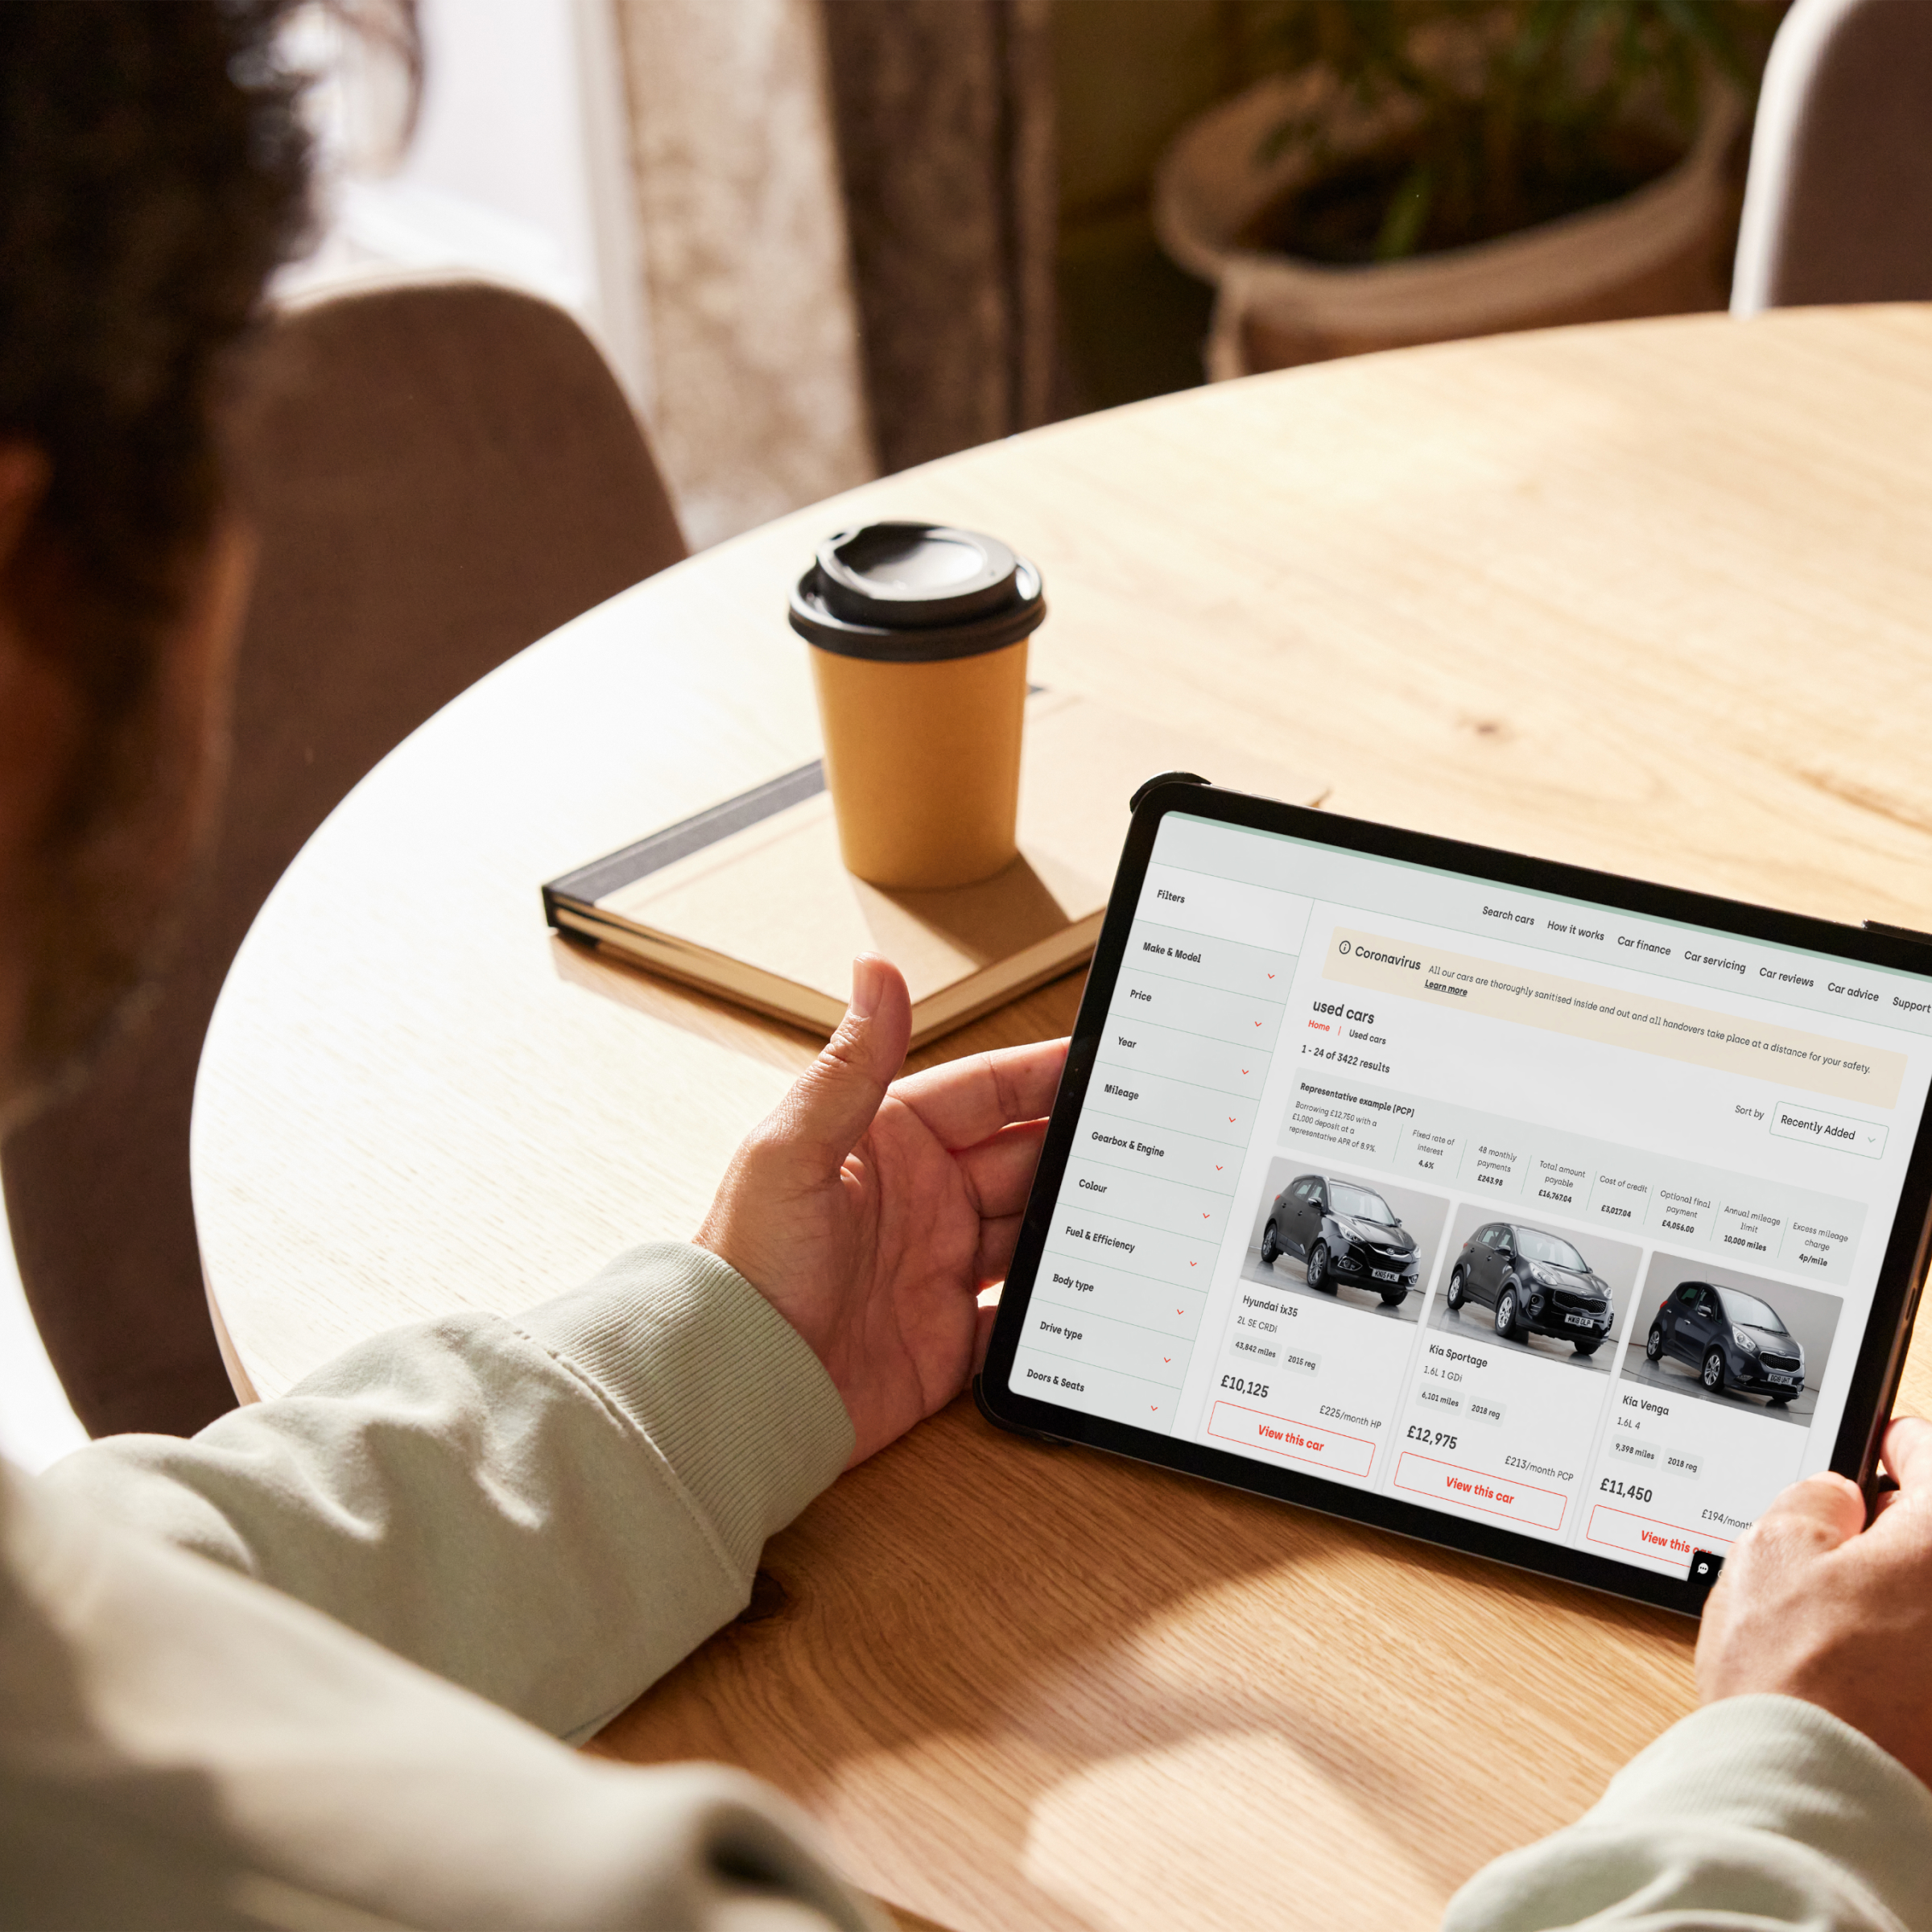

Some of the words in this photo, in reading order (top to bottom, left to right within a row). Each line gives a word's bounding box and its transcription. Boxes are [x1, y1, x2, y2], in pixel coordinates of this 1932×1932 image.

[1156, 889, 1186, 904] Filters
[1482, 906, 1513, 921] Search
[1514, 914, 1535, 926] cars
[1546, 920, 1568, 933] How
[1569, 924, 1577, 935] it
[1578, 928, 1605, 941] works
[1142, 941, 1166, 955] Make
[1166, 947, 1174, 957] &
[1174, 949, 1202, 964] Model
[1617, 935, 1636, 947] Car
[1636, 939, 1671, 956] finance
[1355, 946, 1422, 971] Coronavirus
[1684, 950, 1703, 962] Car
[1703, 956, 1747, 975] servicing
[1759, 967, 1777, 979] Car
[1778, 972, 1814, 988] reviews
[1129, 989, 1152, 1002] Price
[1424, 979, 1447, 993] Learn
[1447, 985, 1468, 997] more
[1827, 982, 1846, 994] Car
[1847, 988, 1880, 1002] advice
[1312, 1001, 1345, 1018] used
[1345, 1009, 1375, 1025] cars
[1892, 996, 1931, 1013] Support
[1307, 1019, 1331, 1032] Home
[1428, 965, 1441, 976] All
[1441, 970, 1455, 978] our
[1456, 973, 1474, 983] cars
[1475, 977, 1489, 986] are
[1490, 979, 1534, 997] thoroughly
[1534, 991, 1573, 1005] sanitised
[1573, 997, 1598, 1011] inside
[1599, 1005, 1616, 1015] and
[1616, 1009, 1631, 1018] out
[1631, 1013, 1649, 1022] and
[1649, 1016, 1662, 1026] all
[1662, 1018, 1705, 1035] handovers
[1707, 1029, 1725, 1040] take
[1725, 1034, 1751, 1046] place
[1752, 1040, 1762, 1049] at
[1770, 1043, 1807, 1059] distance
[1809, 1051, 1822, 1062] for
[1822, 1056, 1842, 1066] your
[1843, 1061, 1870, 1075] safety.
[1118, 1036, 1137, 1049] Year
[1348, 1029, 1369, 1041] Used
[1368, 1035, 1387, 1045] cars
[1301, 1044, 1307, 1054] 1
[1313, 1046, 1325, 1058] 24
[1325, 1051, 1337, 1060] of
[1336, 1052, 1359, 1066] 3422
[1359, 1060, 1390, 1074] results
[1104, 1084, 1139, 1101] Mileage
[1299, 1082, 1358, 1103] Representative
[1359, 1097, 1392, 1112] example
[1295, 1100, 1330, 1117] Borrowing
[1330, 1109, 1356, 1121] £12,750
[1356, 1117, 1371, 1125] with
[1735, 1104, 1752, 1117] Sort
[1753, 1108, 1765, 1121] by
[1292, 1113, 1314, 1125] £1,000
[1315, 1119, 1340, 1131] deposit
[1781, 1114, 1823, 1135] Recently
[1823, 1125, 1856, 1141] Added
[1091, 1131, 1129, 1148] Gearbox
[1128, 1140, 1135, 1150] &
[1136, 1141, 1165, 1158] Engine
[1289, 1126, 1337, 1143] representative
[1337, 1137, 1352, 1146] APR
[1360, 1142, 1376, 1152] 8.9%.
[1412, 1129, 1431, 1140] Fixed
[1431, 1135, 1446, 1144] rate
[1417, 1145, 1443, 1156] interest
[1478, 1146, 1488, 1154] 48
[1488, 1150, 1517, 1162] monthly
[1418, 1159, 1435, 1170] 4.6%
[1476, 1159, 1511, 1173] payments
[1540, 1160, 1558, 1171] Total
[1558, 1166, 1586, 1179] amount
[1079, 1179, 1108, 1194] Colour
[1477, 1174, 1504, 1187] £243.98
[1544, 1176, 1574, 1188] payable
[1600, 1175, 1616, 1186] Cost
[1626, 1183, 1648, 1193] credit
[1538, 1189, 1572, 1203] £16,767.04
[1660, 1190, 1693, 1204] Optional
[1693, 1197, 1711, 1209] final
[1600, 1204, 1632, 1218] £3,017.04
[1666, 1206, 1698, 1219] payment
[1724, 1206, 1750, 1218] Annual
[1750, 1213, 1781, 1227] mileage
[1662, 1220, 1695, 1234] £4,056.00
[1740, 1222, 1758, 1233] limit
[1793, 1222, 1817, 1235] Excess
[1818, 1229, 1848, 1243] mileage
[1065, 1225, 1084, 1239] Fuel
[1084, 1231, 1092, 1241] &
[1092, 1232, 1136, 1254] Efficiency
[1724, 1234, 1746, 1247] 10,000
[1746, 1241, 1767, 1252] miles
[1804, 1239, 1831, 1252] charge
[1798, 1253, 1828, 1267] 4p/mile
[1052, 1273, 1075, 1289] Body
[1075, 1279, 1095, 1293] type
[1242, 1294, 1279, 1312] Hyundai
[1279, 1304, 1298, 1318] ix35
[1039, 1320, 1063, 1335] Drive
[1063, 1327, 1083, 1341] type
[1236, 1315, 1246, 1325] 2L
[1247, 1318, 1257, 1328] SE
[1258, 1321, 1278, 1333] CRDi
[1235, 1341, 1257, 1353] 43,842
[1257, 1348, 1276, 1358] miles
[1429, 1344, 1445, 1356] Kia
[1445, 1348, 1488, 1368] Sportage
[1287, 1355, 1304, 1365] 2015
[1304, 1360, 1316, 1371] reg
[1026, 1368, 1052, 1383] Doors
[1052, 1375, 1059, 1385] &
[1060, 1377, 1085, 1393] Seats
[1423, 1365, 1439, 1377] 1.6L
[1447, 1372, 1463, 1382] GDi
[1220, 1374, 1269, 1398] £10,125
[1421, 1391, 1439, 1402] 6,101
[1439, 1397, 1459, 1407] miles
[1622, 1394, 1639, 1407] Kia
[1641, 1399, 1670, 1417] Venga
[1319, 1405, 1369, 1426] £225/month
[1369, 1419, 1382, 1429] HP
[1471, 1404, 1488, 1415] 2018
[1488, 1410, 1501, 1420] reg
[1616, 1417, 1633, 1428] 1.6L
[1634, 1422, 1641, 1430] 4
[1258, 1424, 1284, 1441] View
[1285, 1432, 1305, 1447] this
[1306, 1440, 1325, 1452] car
[1406, 1425, 1458, 1450] £12,975
[1616, 1443, 1634, 1454] 9,398
[1634, 1449, 1655, 1460] miles
[1505, 1455, 1556, 1477] £213/month
[1557, 1470, 1574, 1481] PCP
[1667, 1457, 1685, 1468] 2018
[1685, 1463, 1698, 1473] reg
[1447, 1476, 1473, 1493] View
[1474, 1484, 1494, 1499] this
[1495, 1492, 1515, 1505] car
[1600, 1477, 1653, 1503] £11,450
[1641, 1530, 1669, 1547] View
[1670, 1538, 1691, 1554] this
